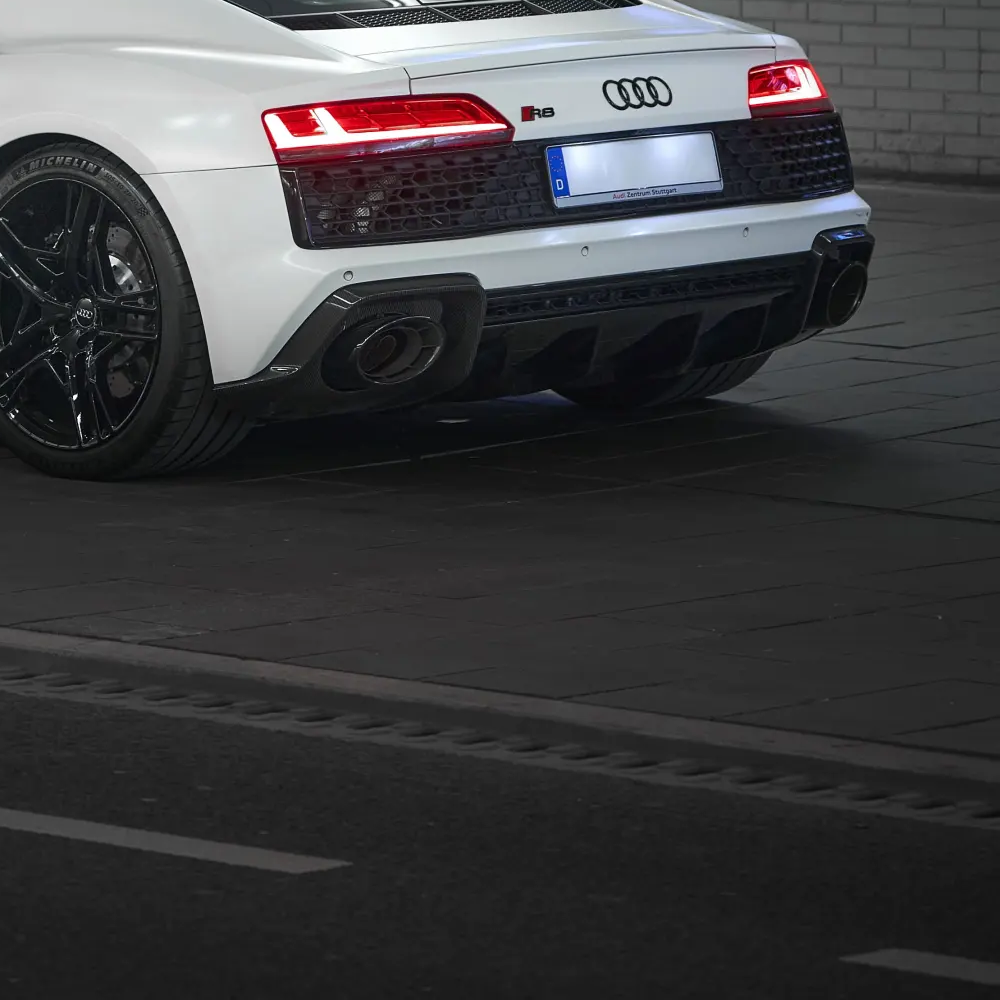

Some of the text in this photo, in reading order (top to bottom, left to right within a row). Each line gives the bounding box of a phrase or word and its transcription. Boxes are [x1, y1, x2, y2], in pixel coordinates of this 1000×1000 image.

[531, 107, 555, 118] R8
[29, 156, 98, 173] MICHELIN
[556, 179, 564, 191] D
[651, 188, 677, 196] Stuttgart
